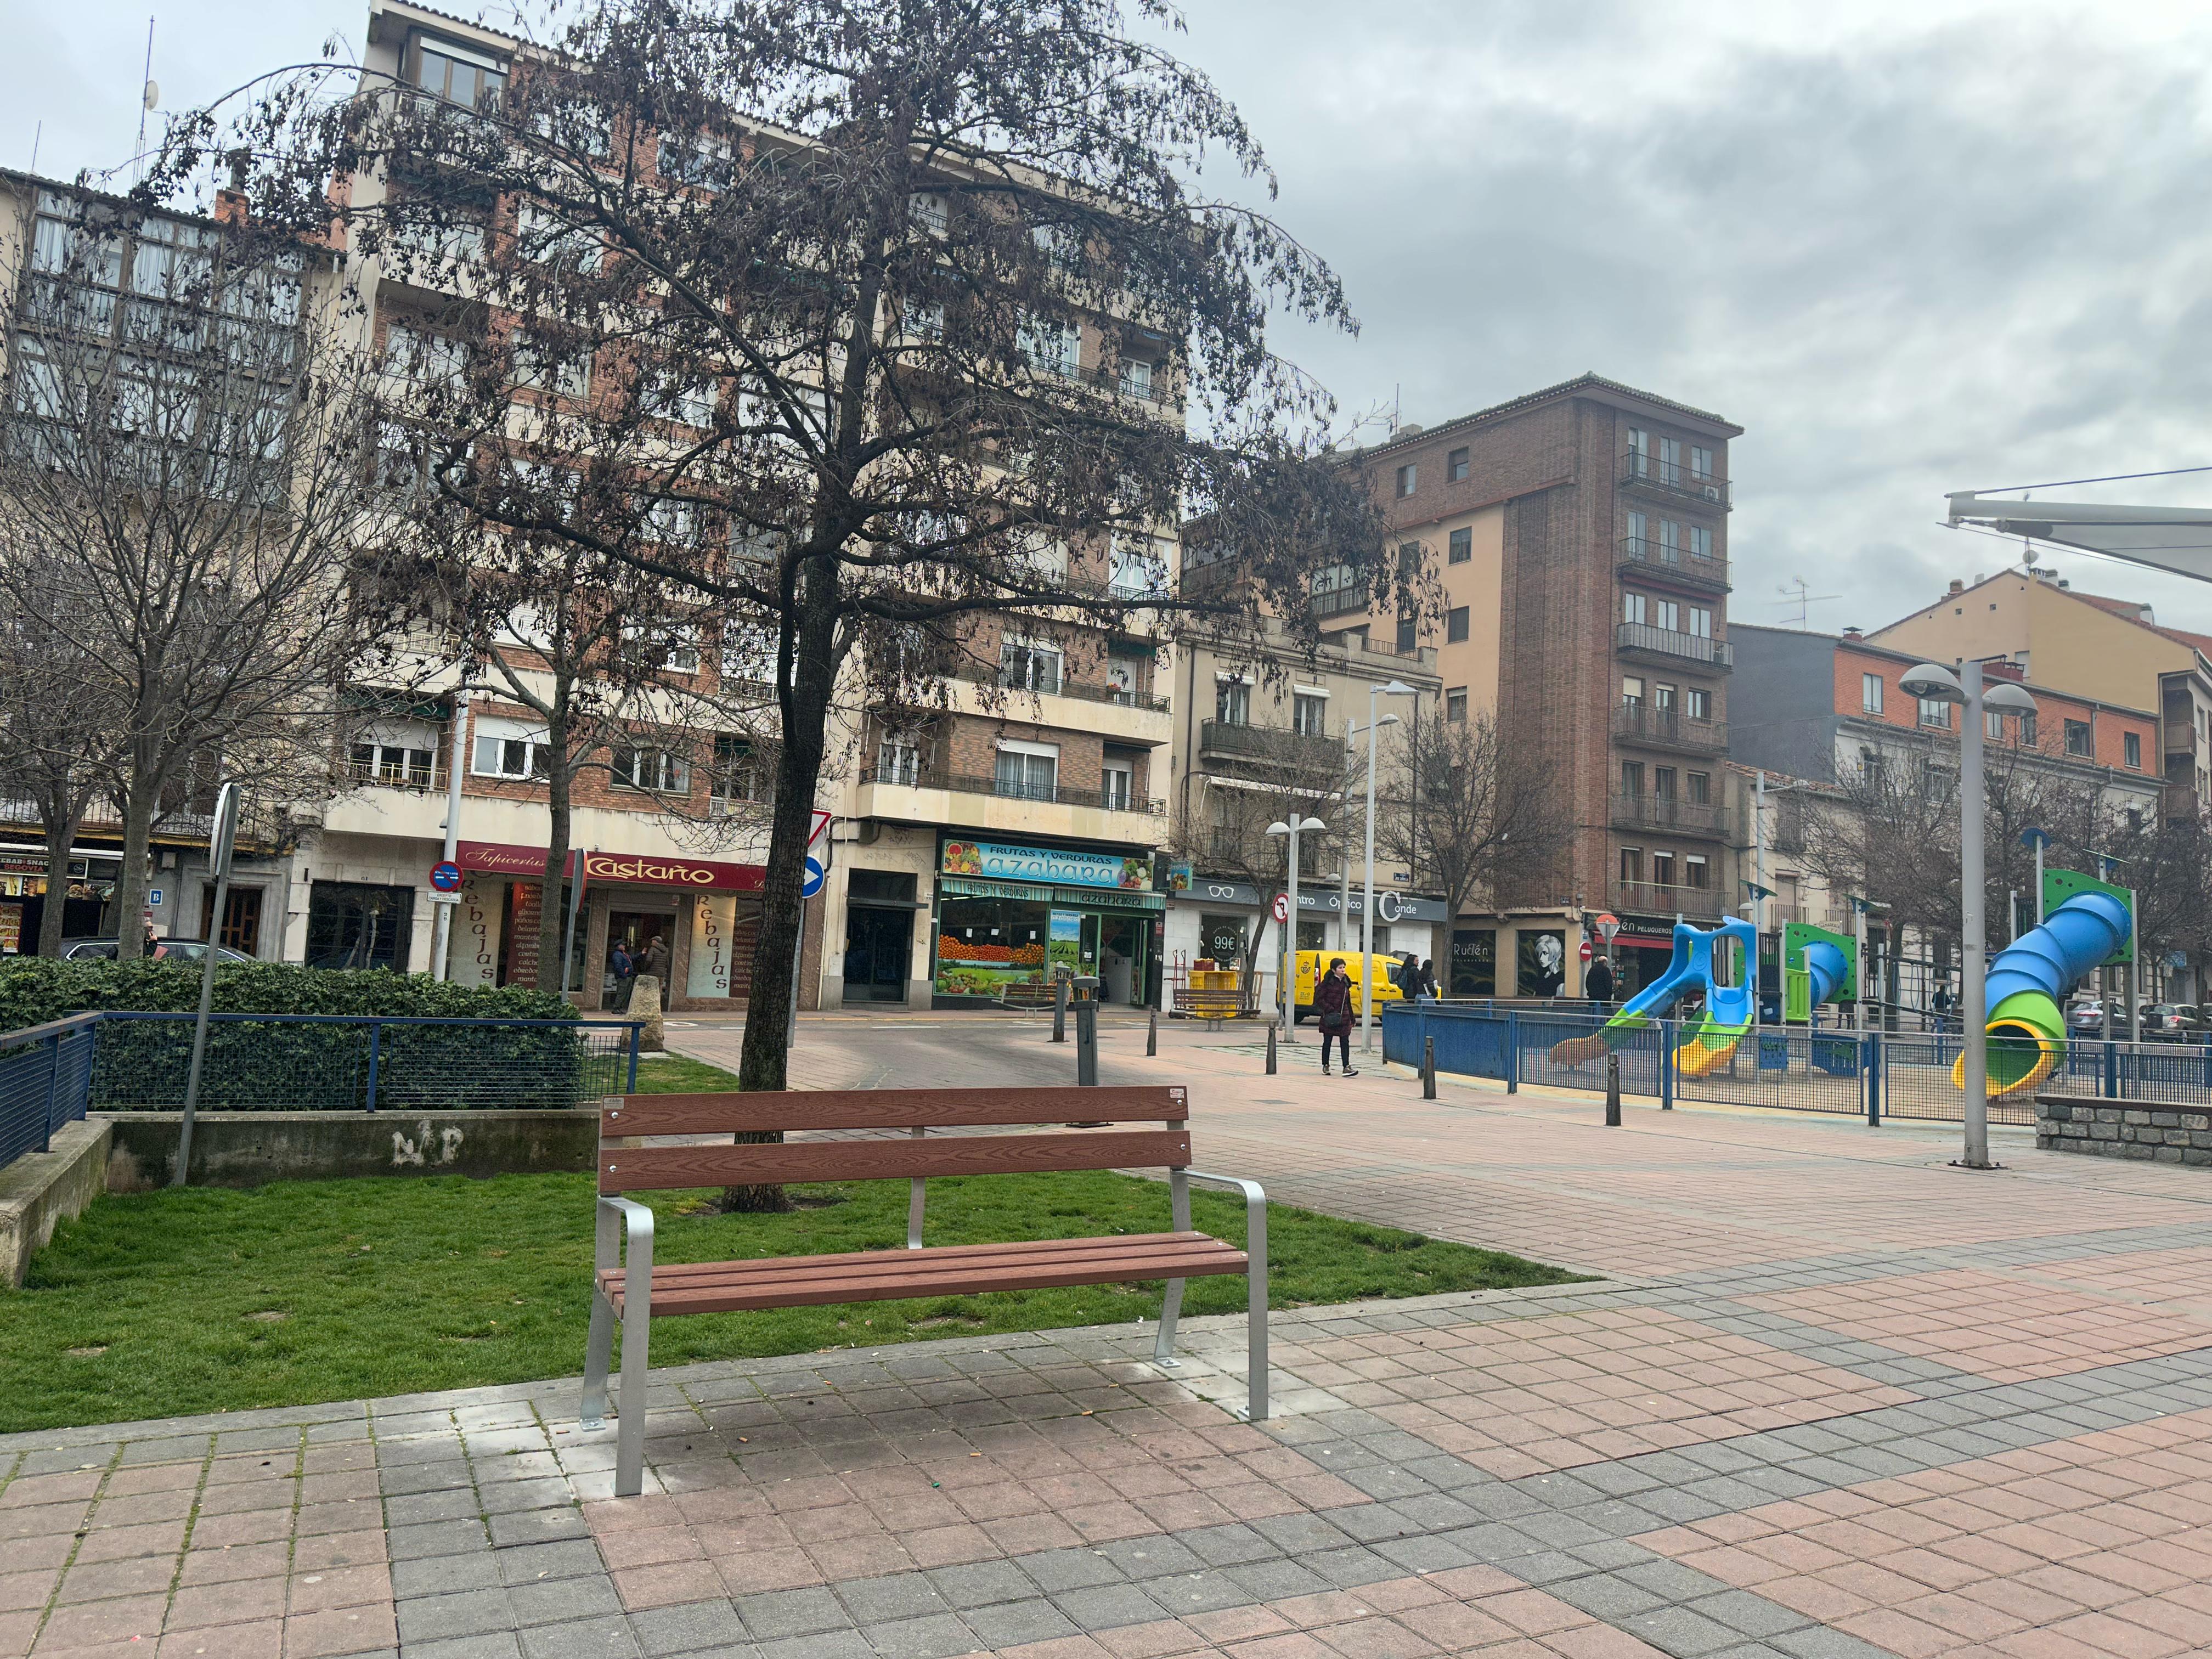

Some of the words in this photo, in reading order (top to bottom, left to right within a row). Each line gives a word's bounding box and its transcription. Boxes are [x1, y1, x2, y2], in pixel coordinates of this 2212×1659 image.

[465, 848, 545, 867] Tapicerías
[990, 847, 1036, 857] FRUTAS
[1051, 853, 1112, 865] VERDURAS
[586, 857, 714, 884] Castaño
[967, 884, 989, 894] FRUTAS
[999, 887, 1028, 897] VERDURAS
[1296, 896, 1316, 905] ntro
[1379, 890, 1417, 922] Conde
[1638, 926, 1672, 934] PELUQUEROS
[1215, 936, 1235, 950] 99€
